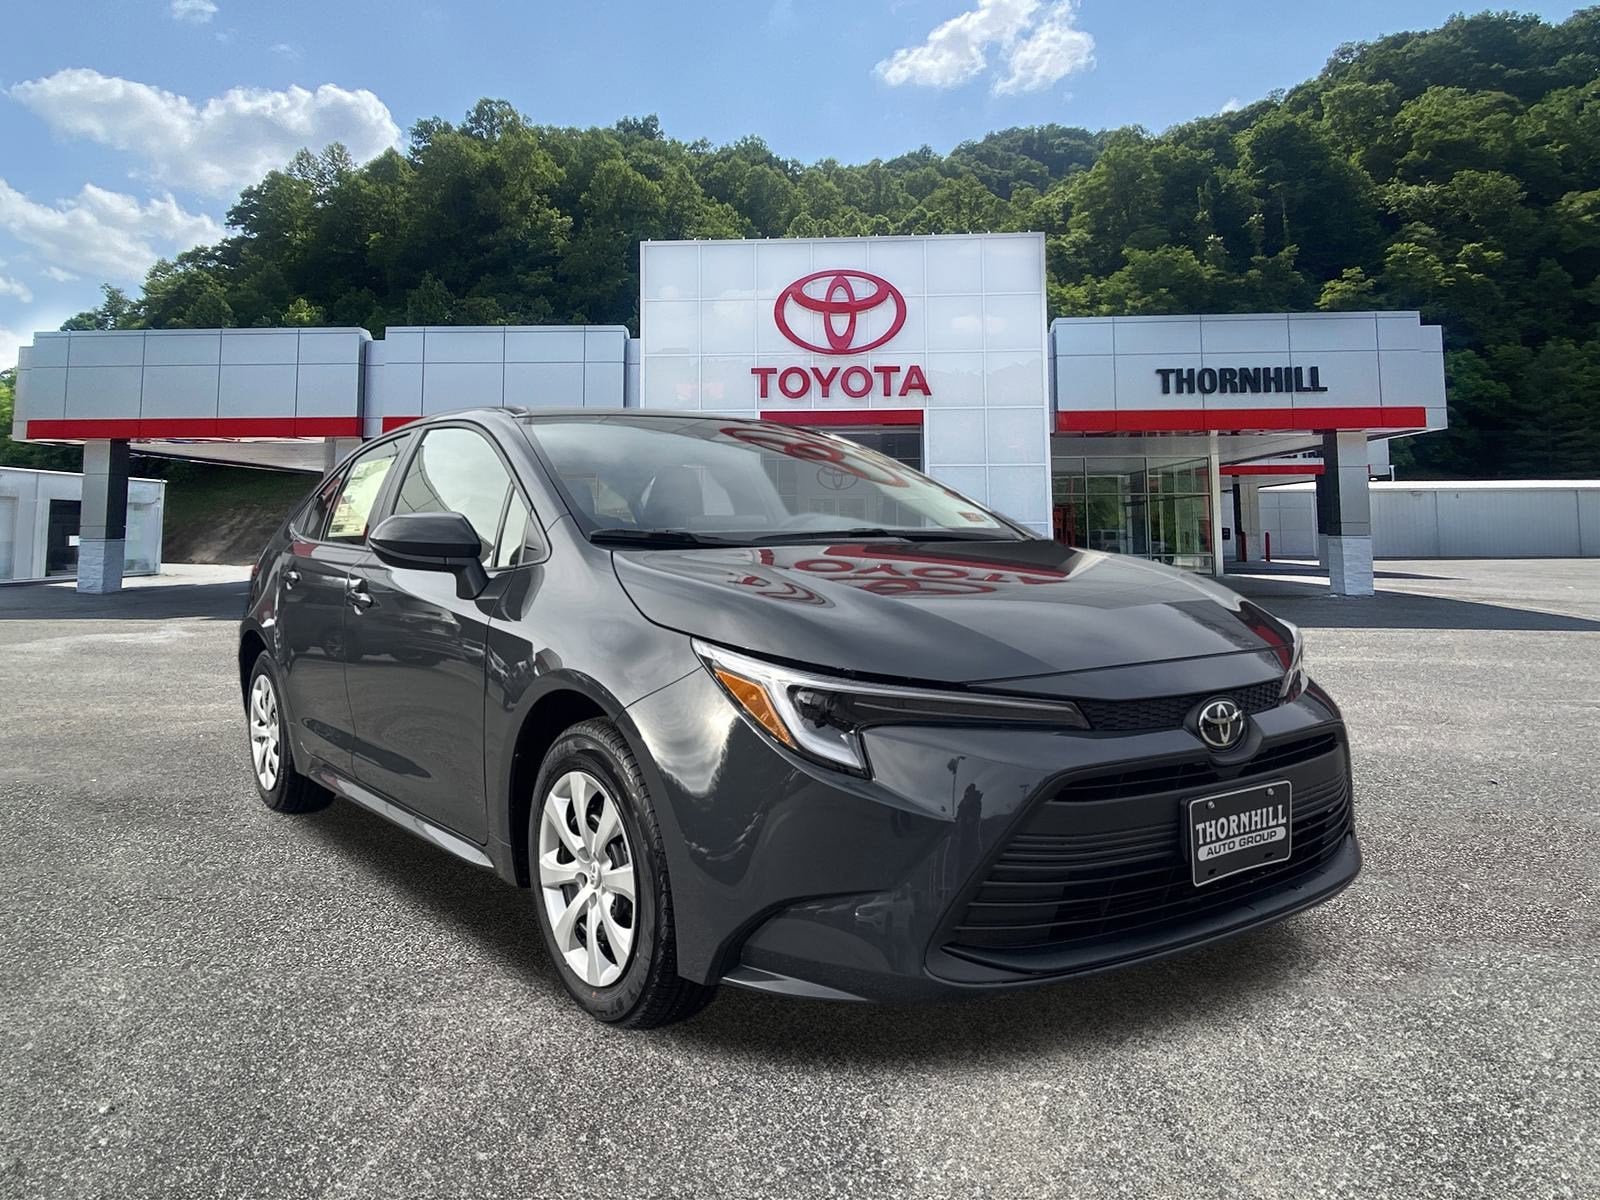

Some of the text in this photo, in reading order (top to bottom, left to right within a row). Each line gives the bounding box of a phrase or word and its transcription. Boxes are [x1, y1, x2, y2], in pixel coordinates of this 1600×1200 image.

[751, 365, 932, 399] TOYOTA
[1155, 366, 1329, 394] THORNHILL
[1195, 804, 1287, 845] THORNHILL
[1206, 830, 1278, 857] AUTO GROUP
